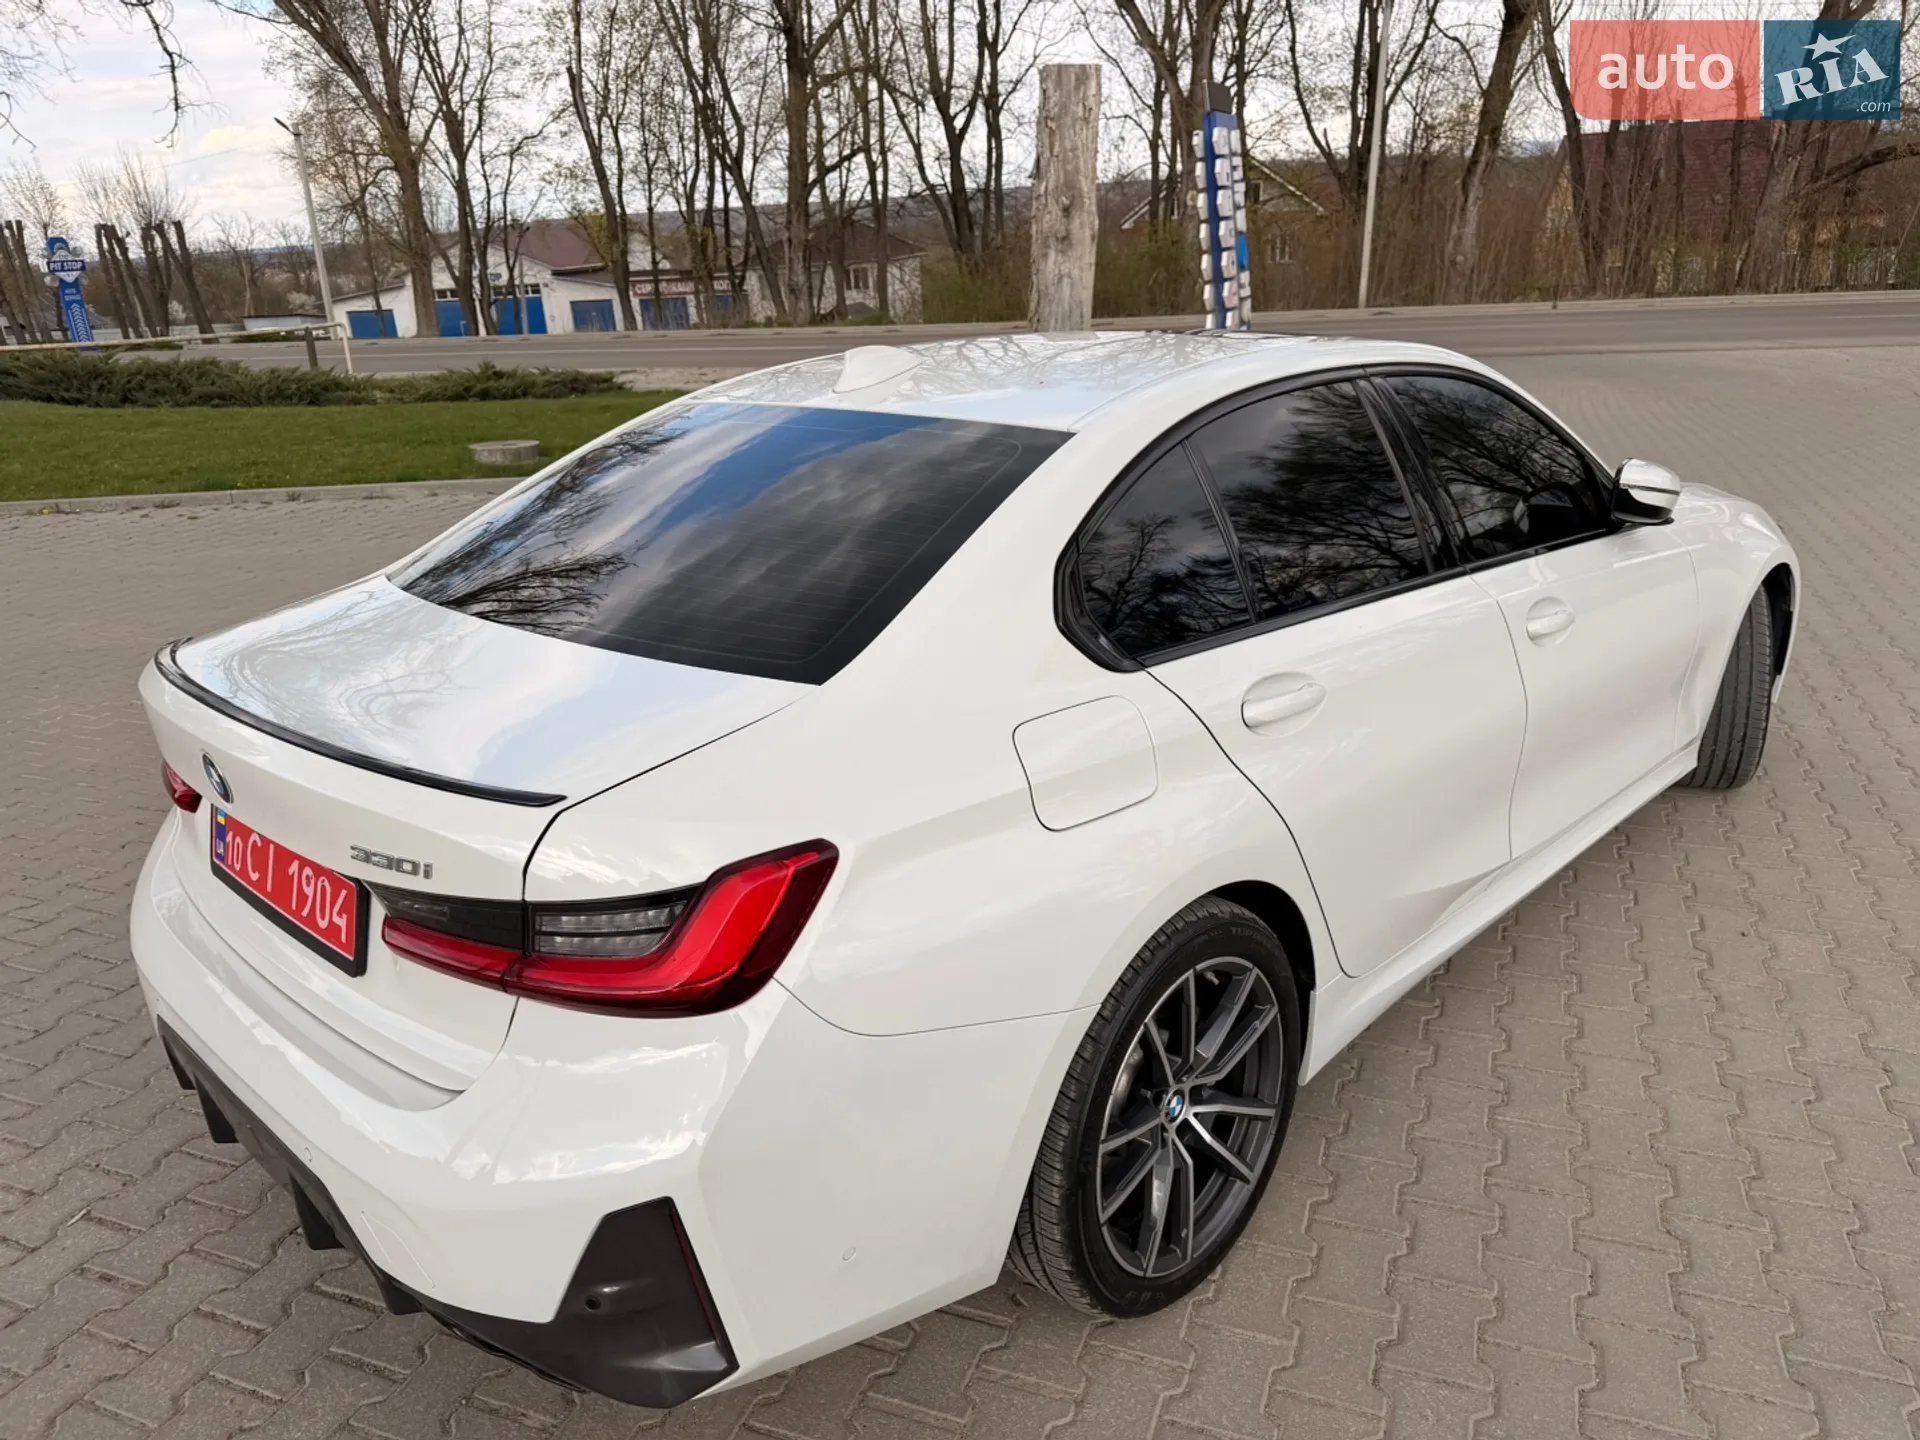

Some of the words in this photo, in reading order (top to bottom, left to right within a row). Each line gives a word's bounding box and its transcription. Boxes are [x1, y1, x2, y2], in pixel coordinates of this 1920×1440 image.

[49, 261, 62, 271] PIT
[63, 261, 82, 271] STOP
[350, 844, 433, 880] 330i
[288, 859, 348, 943] 1904
